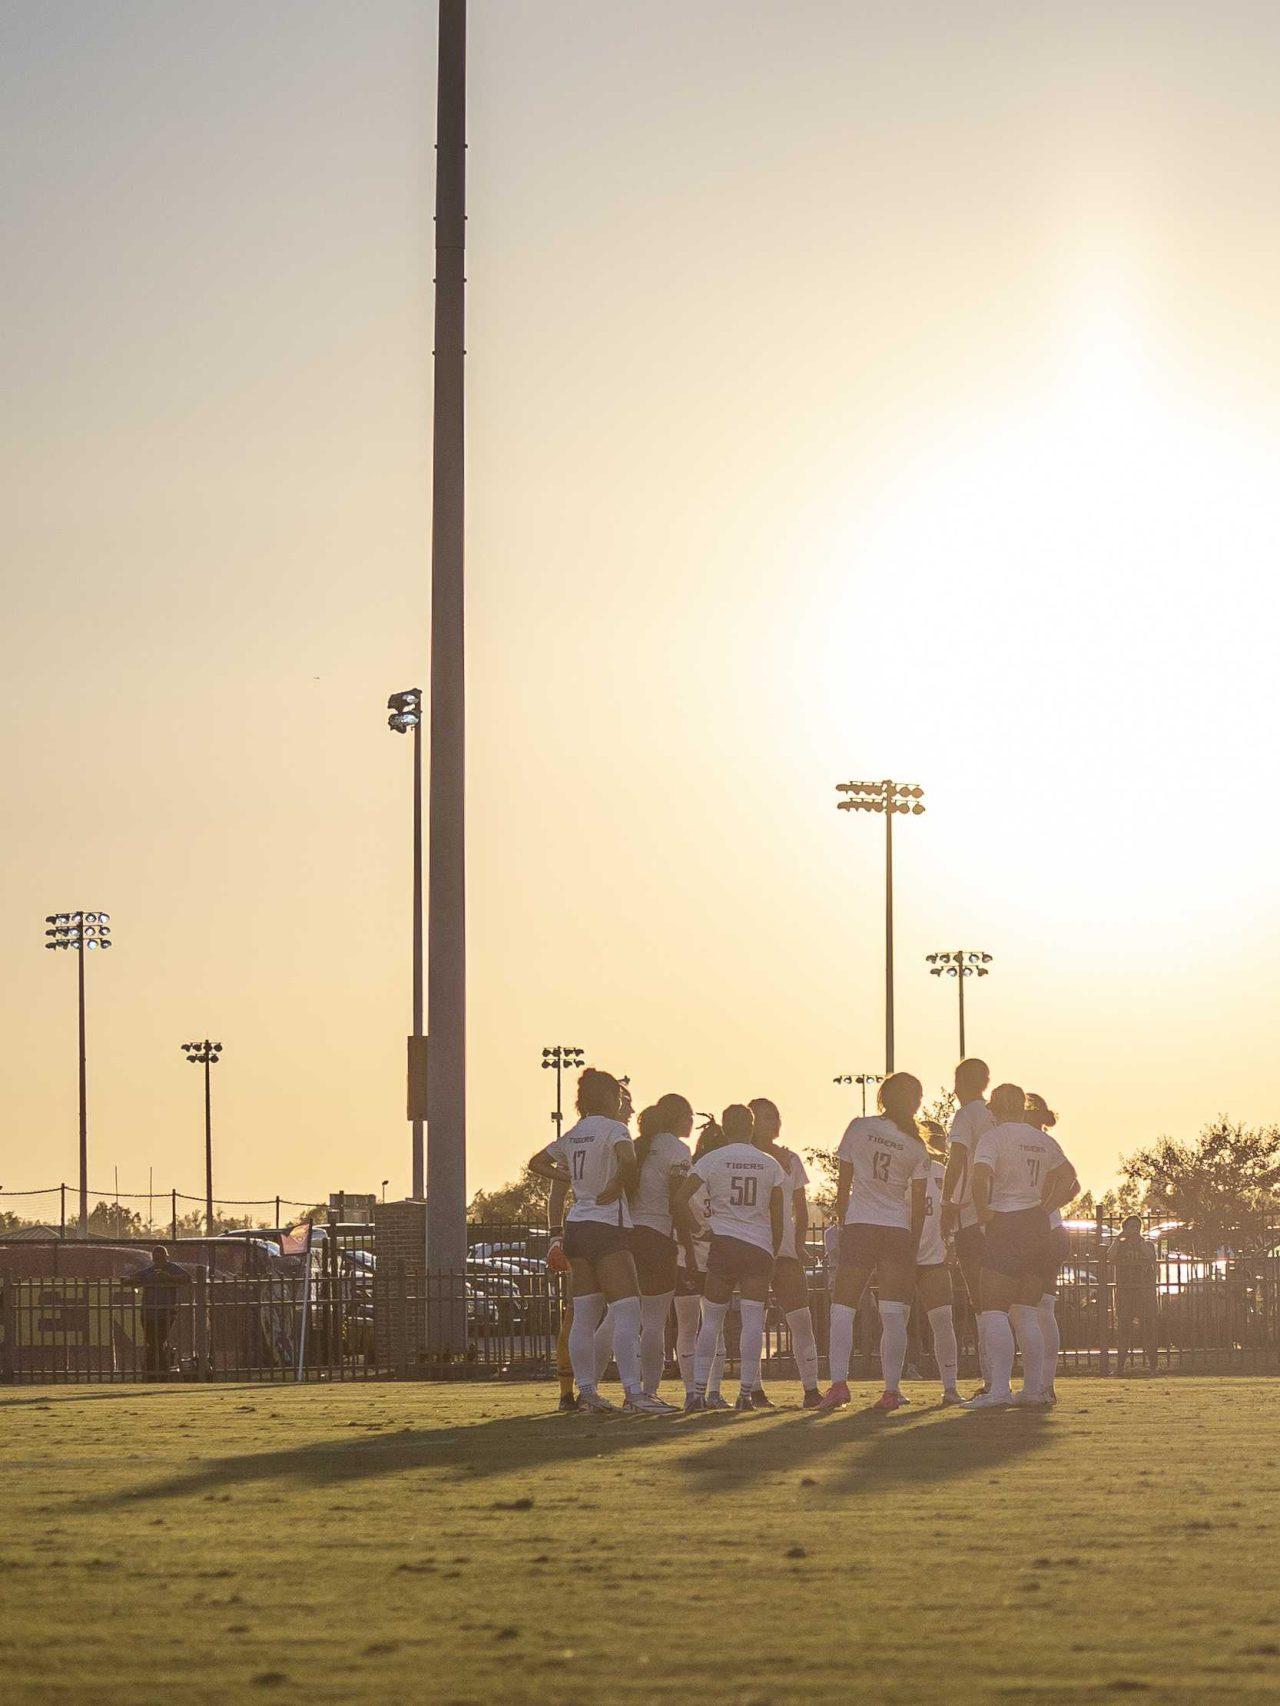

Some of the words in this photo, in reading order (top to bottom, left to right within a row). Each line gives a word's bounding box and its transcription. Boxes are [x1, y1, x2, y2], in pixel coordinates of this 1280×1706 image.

[868, 1134, 905, 1151] TIGERS
[573, 1151, 586, 1180] 17
[726, 1162, 765, 1171] TIGERS
[873, 1151, 892, 1182] 13
[730, 1176, 757, 1207] 50
